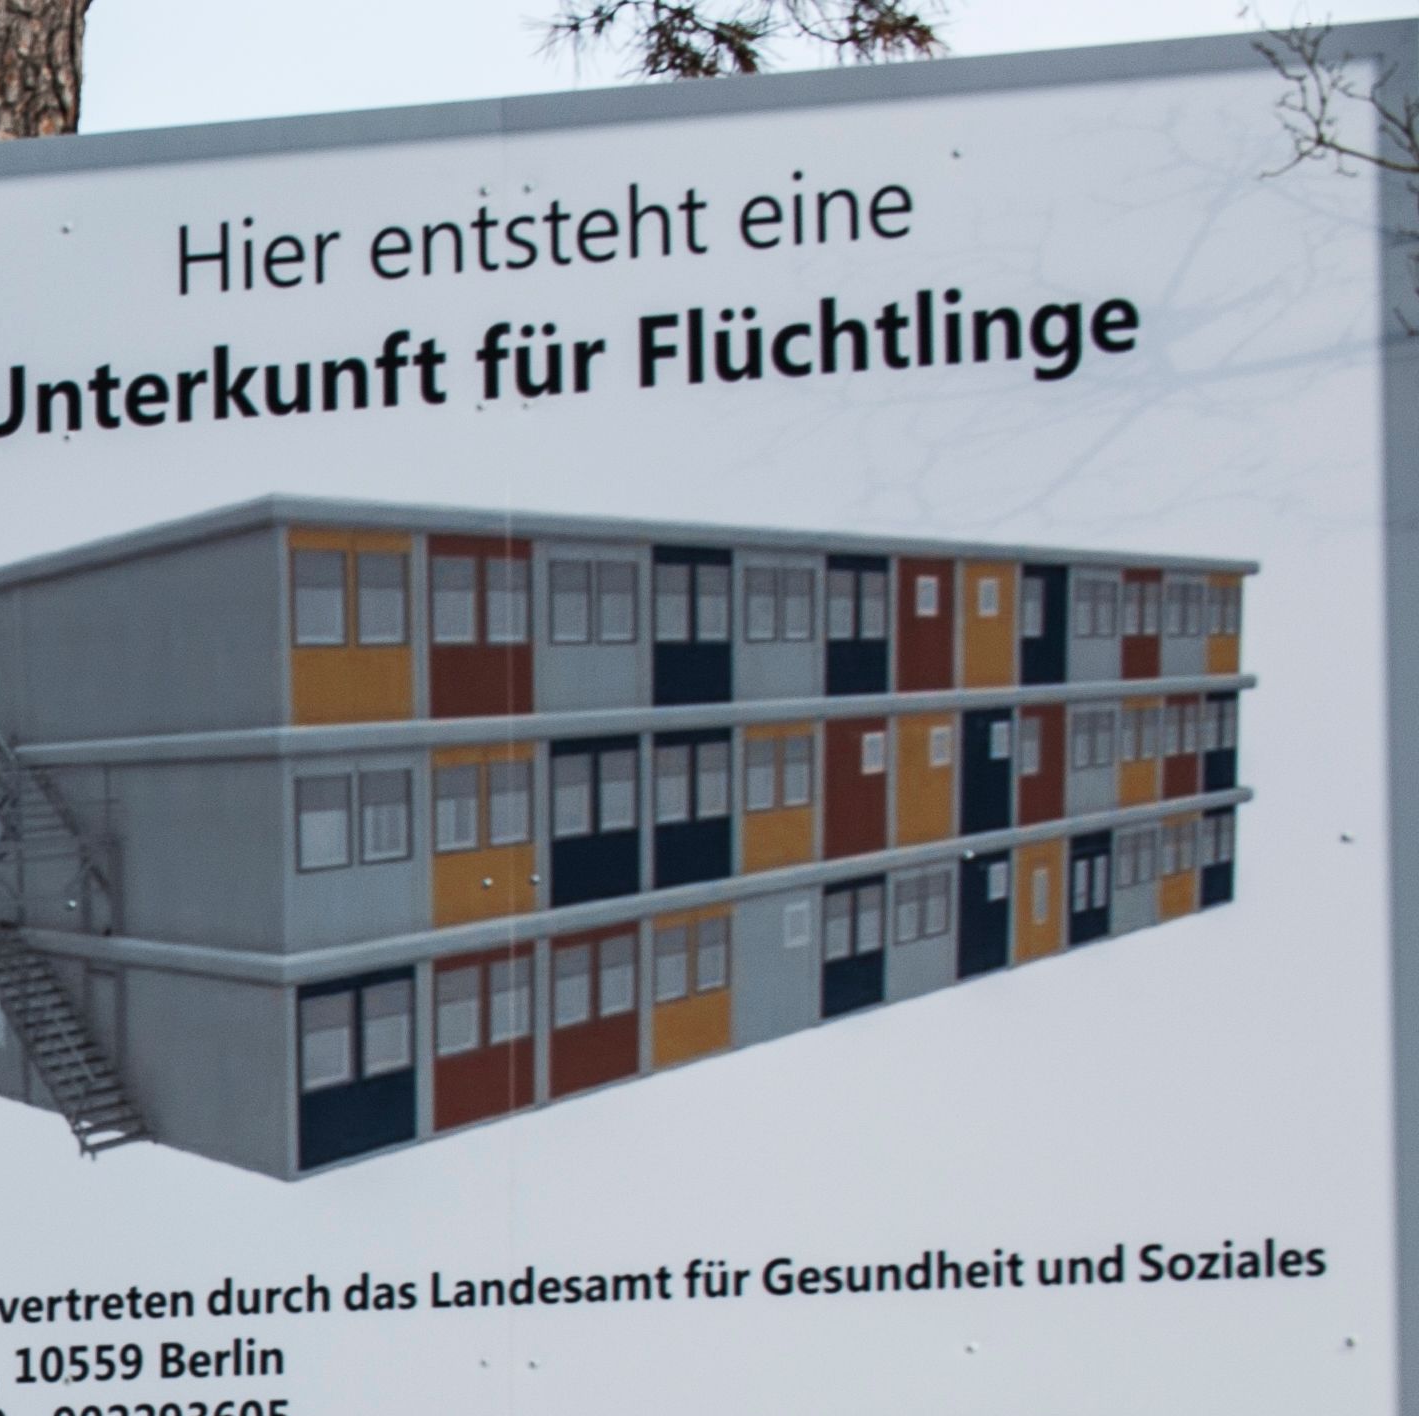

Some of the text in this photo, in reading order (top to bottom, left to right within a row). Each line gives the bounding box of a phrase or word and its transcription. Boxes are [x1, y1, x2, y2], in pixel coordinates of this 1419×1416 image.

[177, 169, 914, 297] Hier entsteht eine
[475, 321, 607, 401] für
[638, 287, 1140, 389] Flüchtlinge
[207, 1274, 331, 1317] durch
[343, 1271, 418, 1312] das
[431, 1265, 672, 1309] Landesamt
[683, 1258, 751, 1299] für
[762, 1248, 1024, 1296] Gesundheit
[1037, 1243, 1124, 1287] und
[1139, 1237, 1327, 1283] Soziales
[15, 1343, 144, 1384] 10559
[160, 1337, 284, 1379] Berlin
